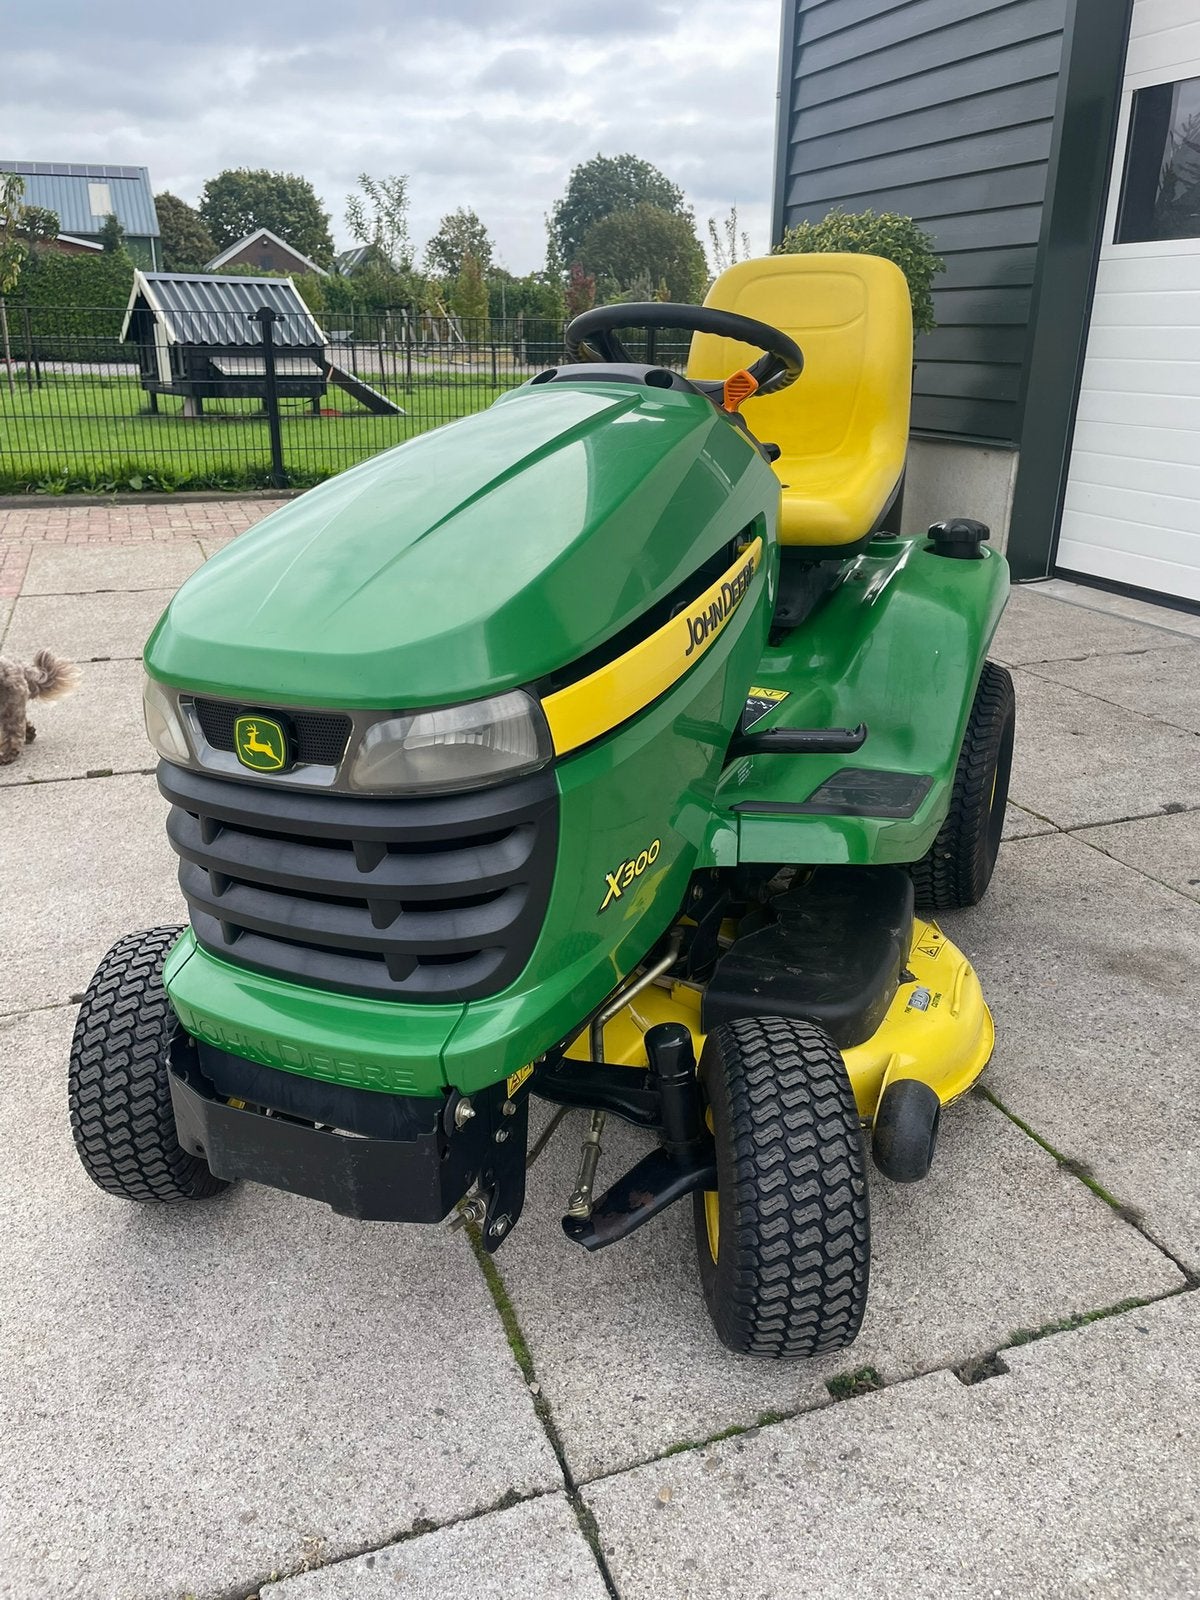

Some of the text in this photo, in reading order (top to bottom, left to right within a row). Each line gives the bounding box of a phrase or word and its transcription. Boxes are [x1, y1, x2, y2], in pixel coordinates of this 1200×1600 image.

[685, 557, 755, 656] JOHN DEERE
[596, 838, 661, 917] X300
[187, 1010, 418, 1091] JOHN DEERE
